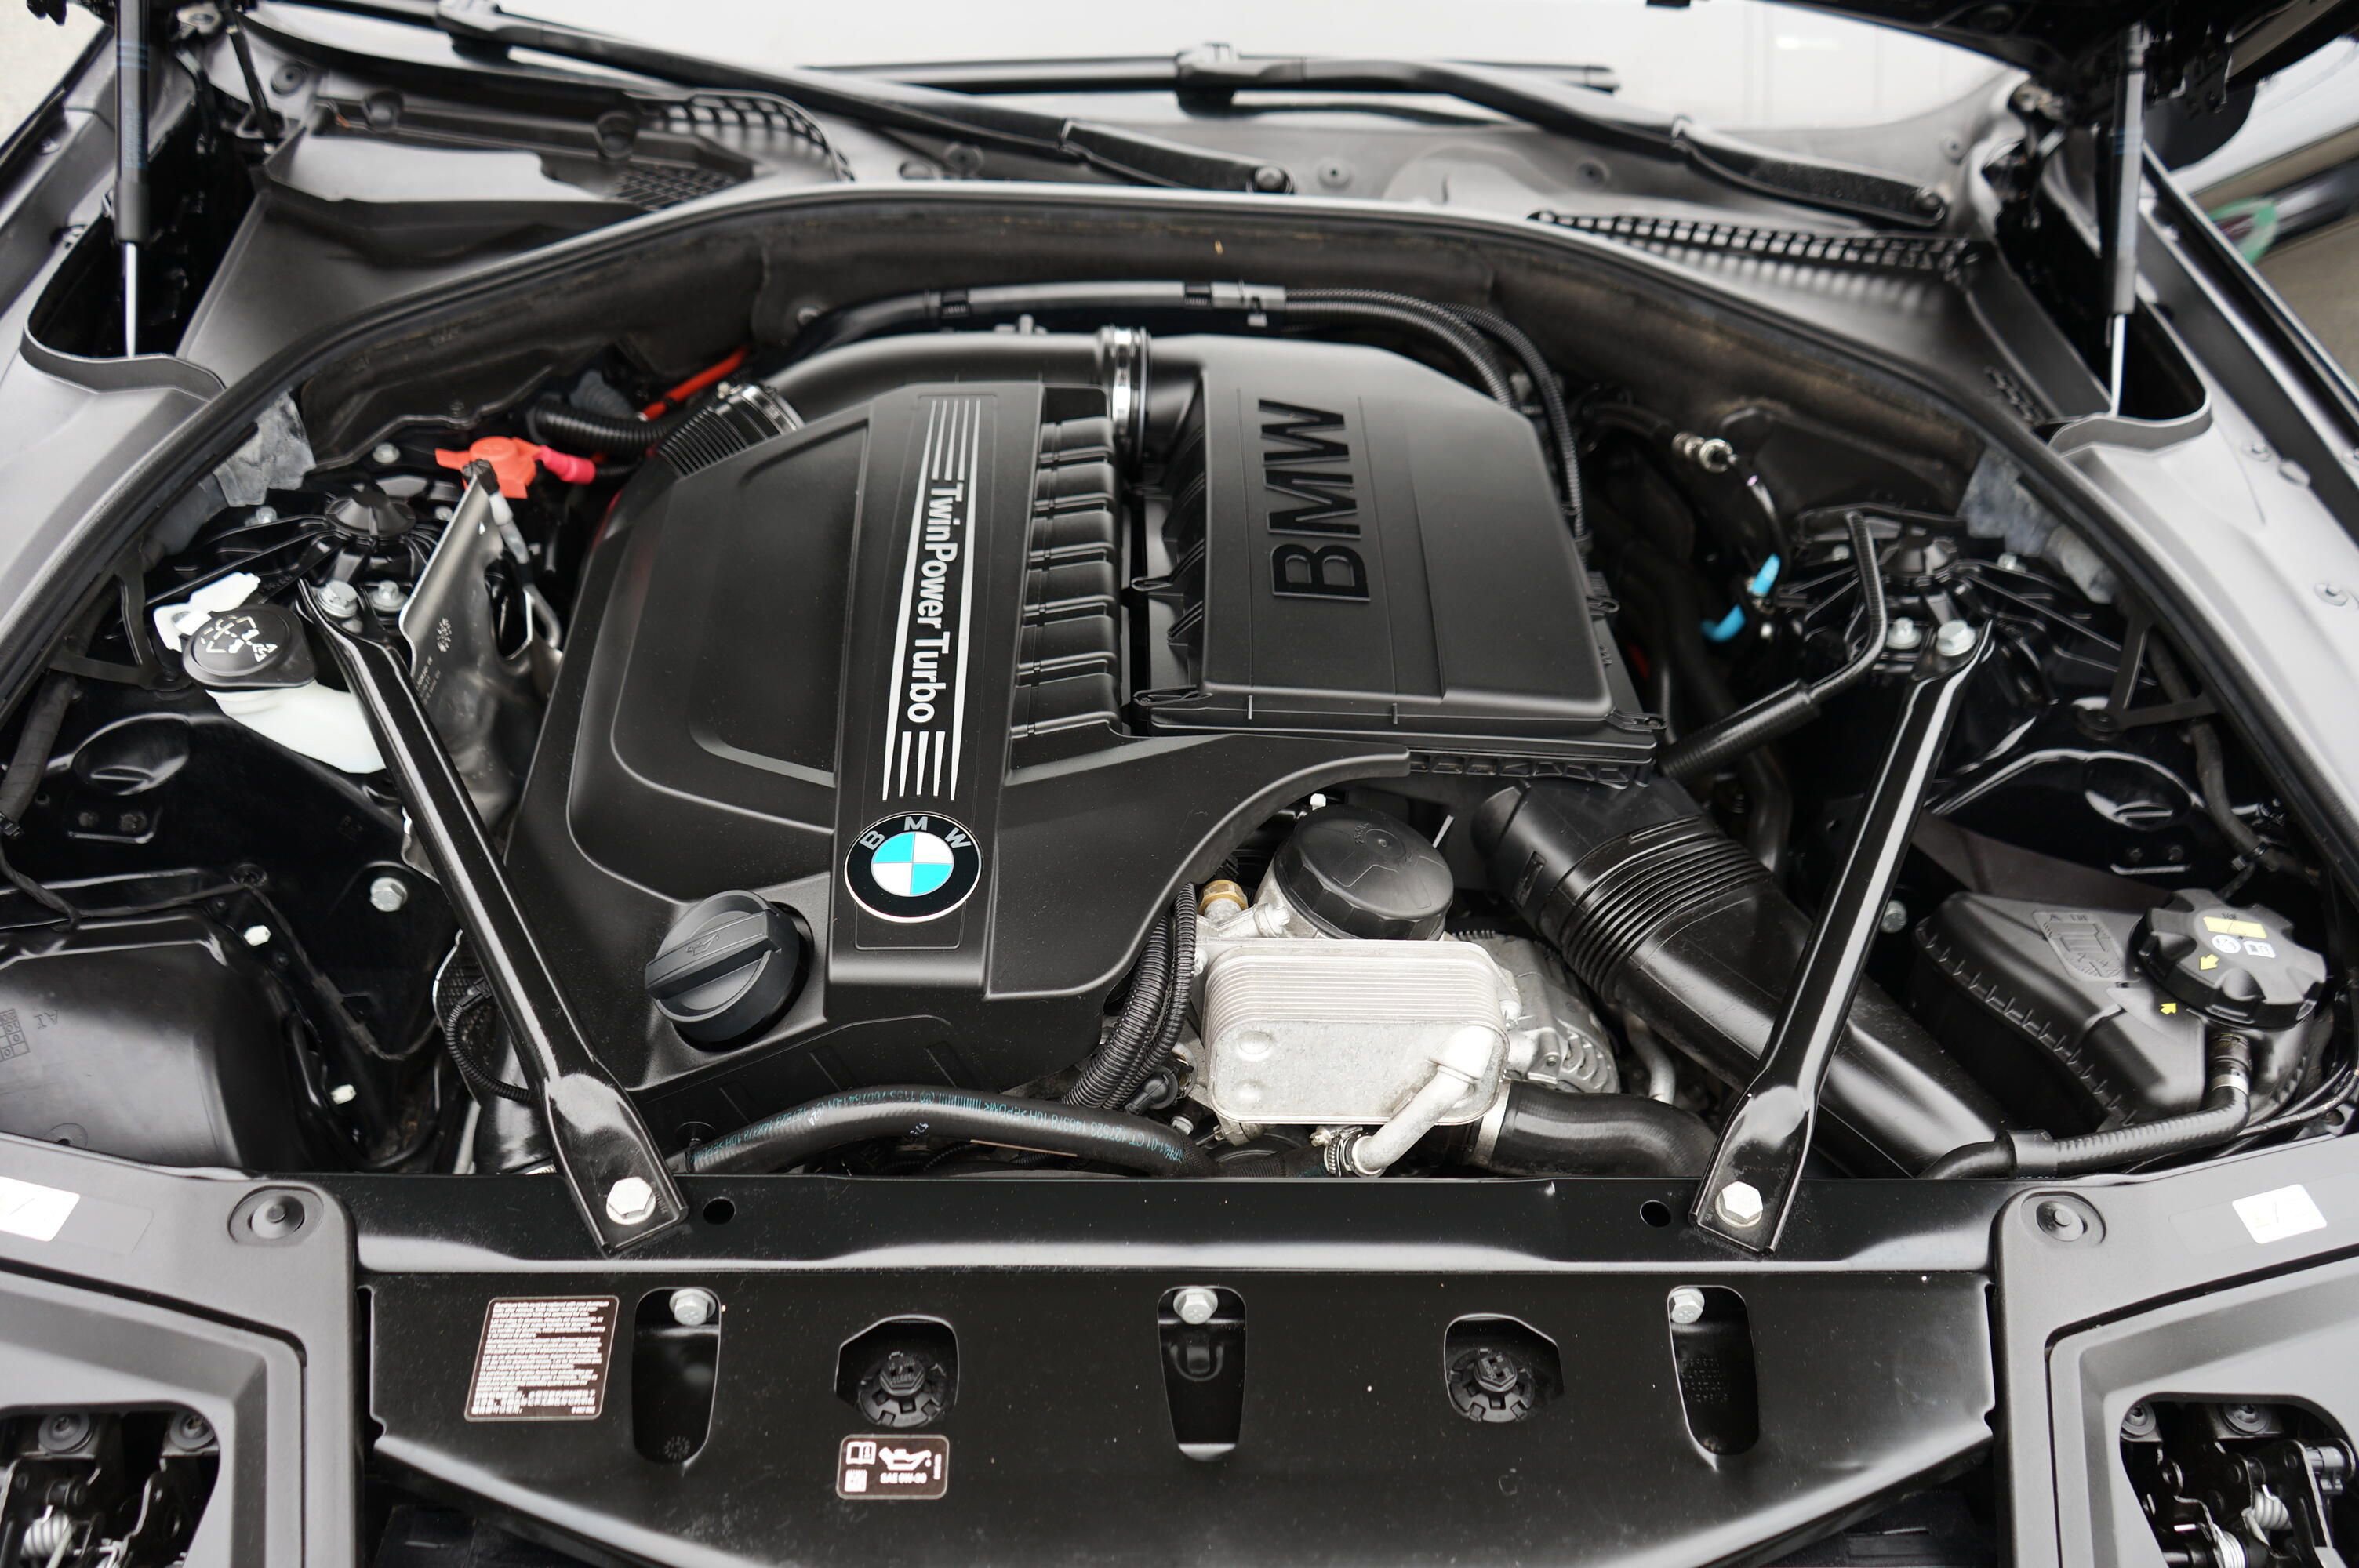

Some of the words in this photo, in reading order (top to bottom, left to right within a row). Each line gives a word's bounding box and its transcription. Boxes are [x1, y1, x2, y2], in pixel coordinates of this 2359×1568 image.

[917, 482, 963, 629] TwinPower
[1259, 399, 1370, 601] BMW
[907, 631, 951, 724] Turbo
[860, 815, 971, 851] BMW
